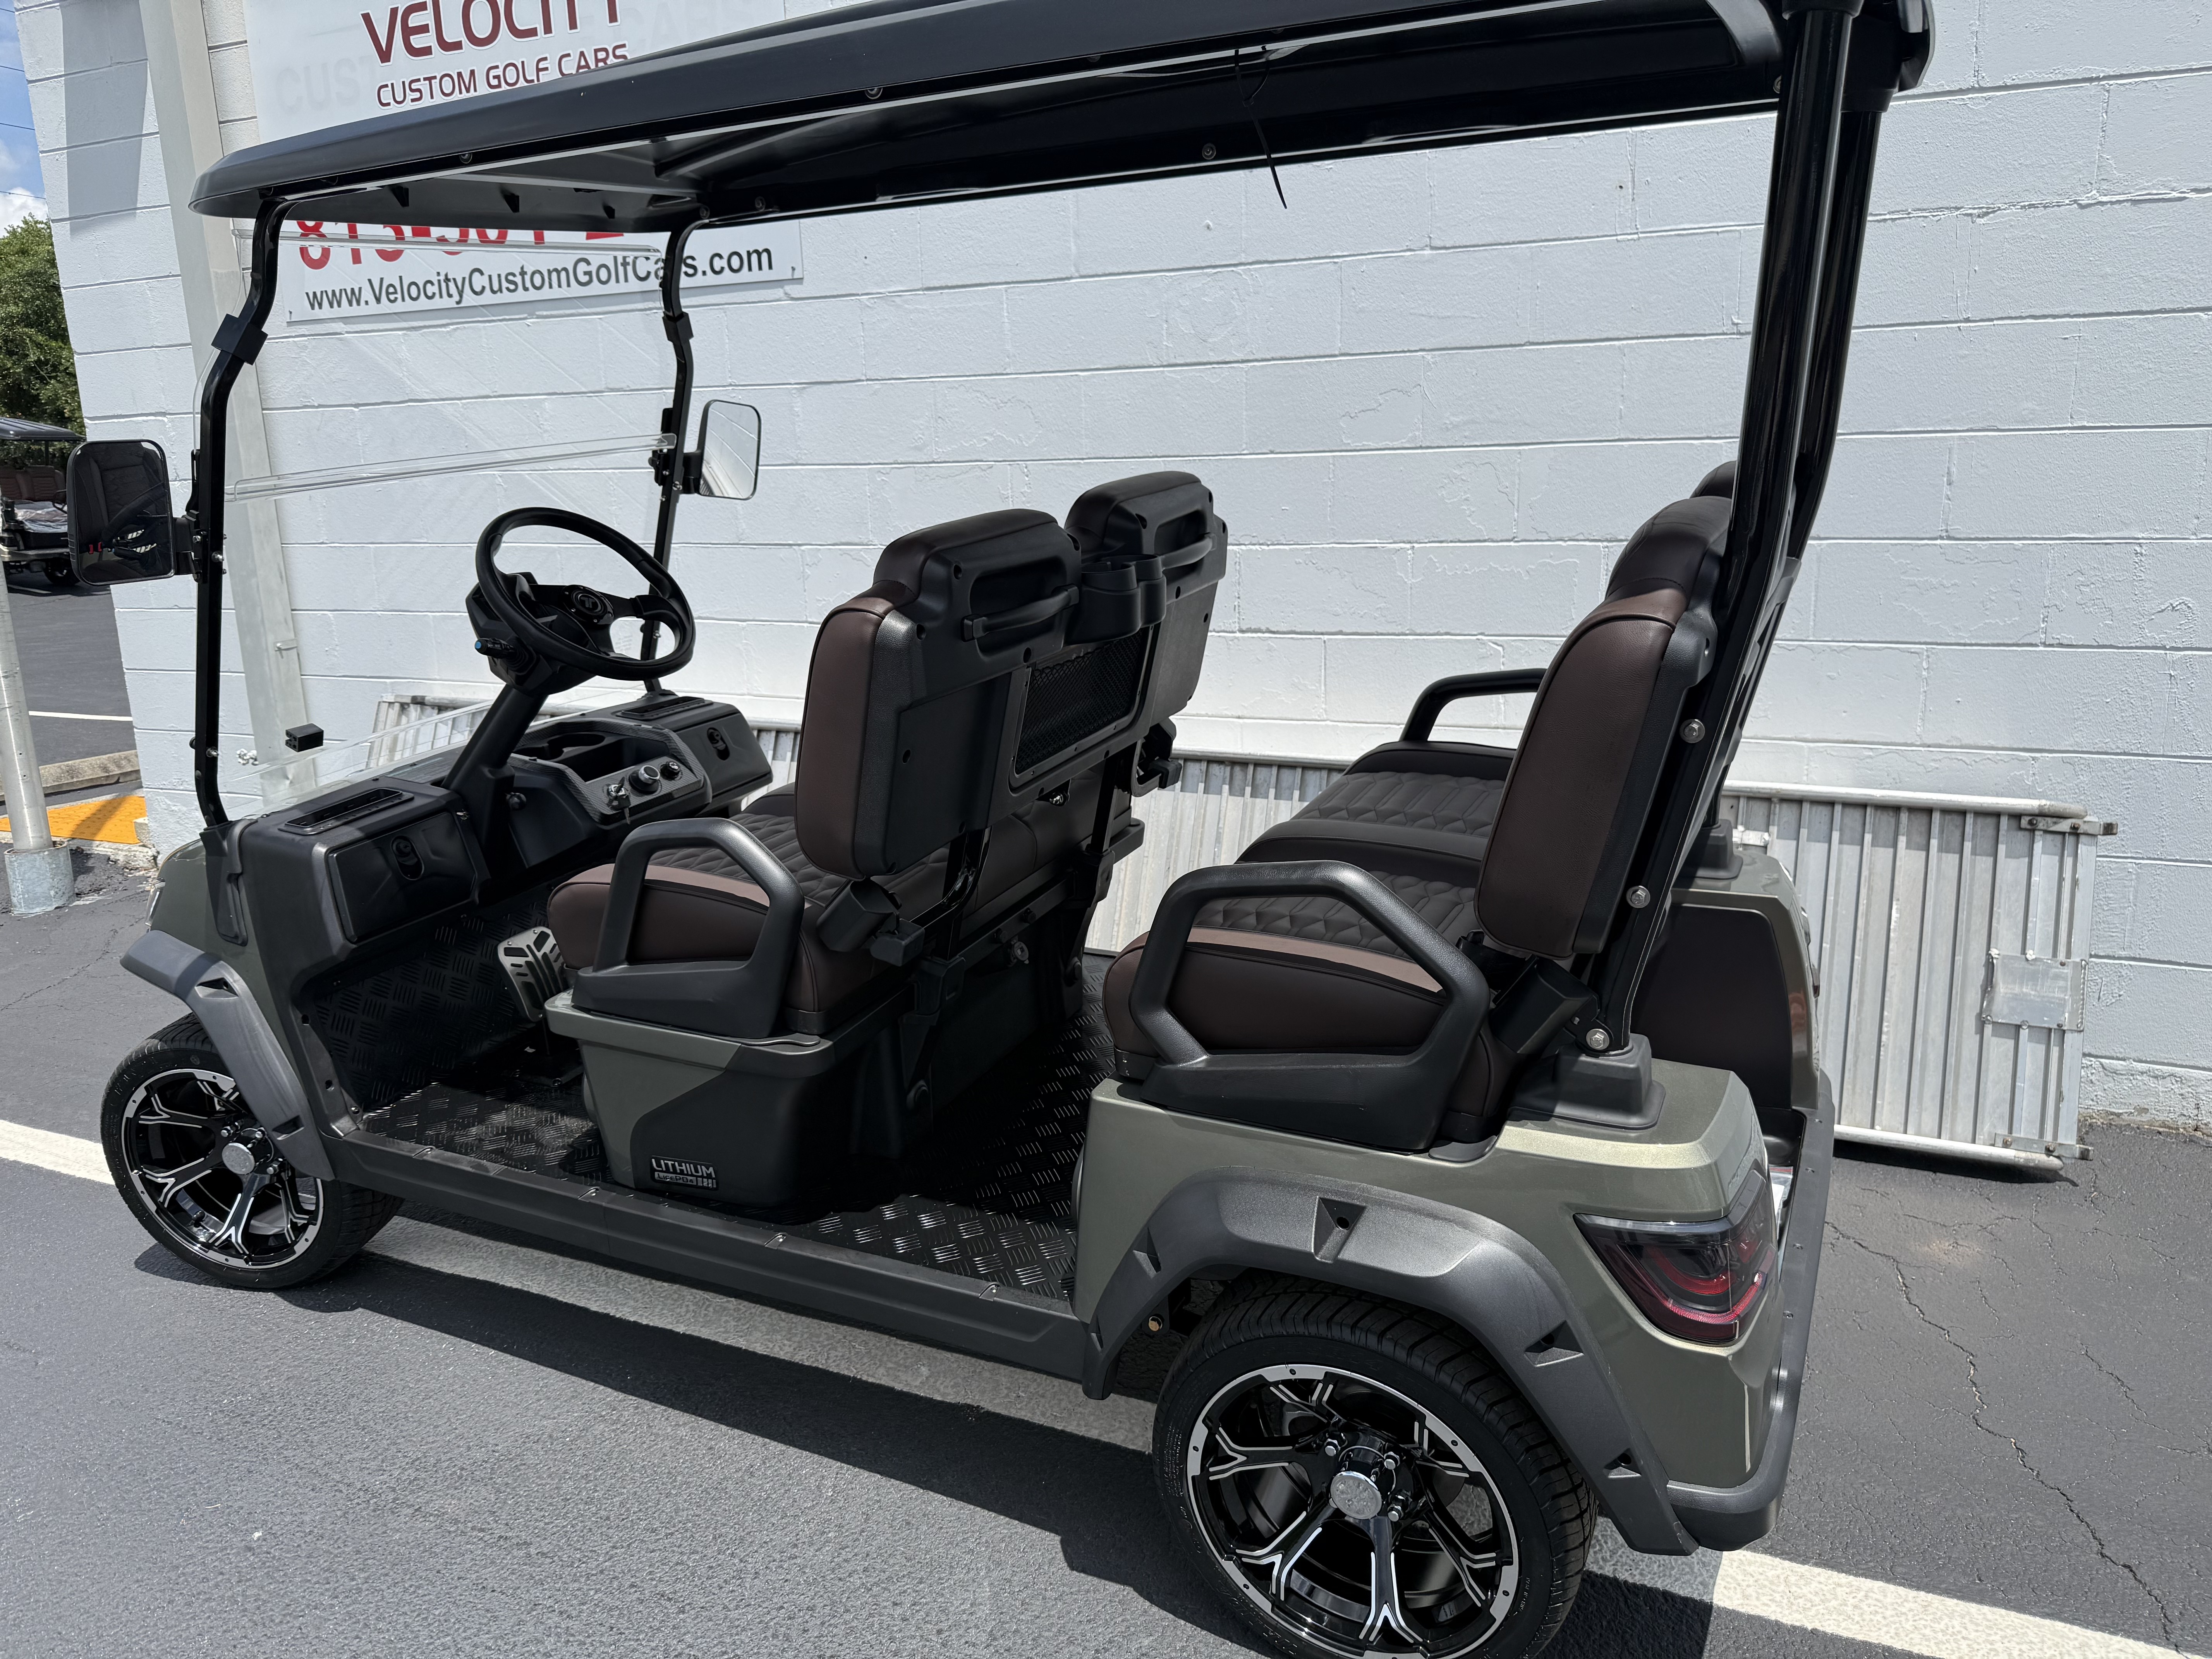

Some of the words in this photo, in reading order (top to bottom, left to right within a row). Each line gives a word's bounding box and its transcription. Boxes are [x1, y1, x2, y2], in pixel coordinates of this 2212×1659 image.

[377, 69, 477, 107] CUSTOM
[486, 56, 549, 89] GOLF
[558, 43, 629, 78] CARS
[305, 248, 773, 311] www.VelocityCustomGolfCas.com
[652, 1159, 715, 1178] LITHIUM
